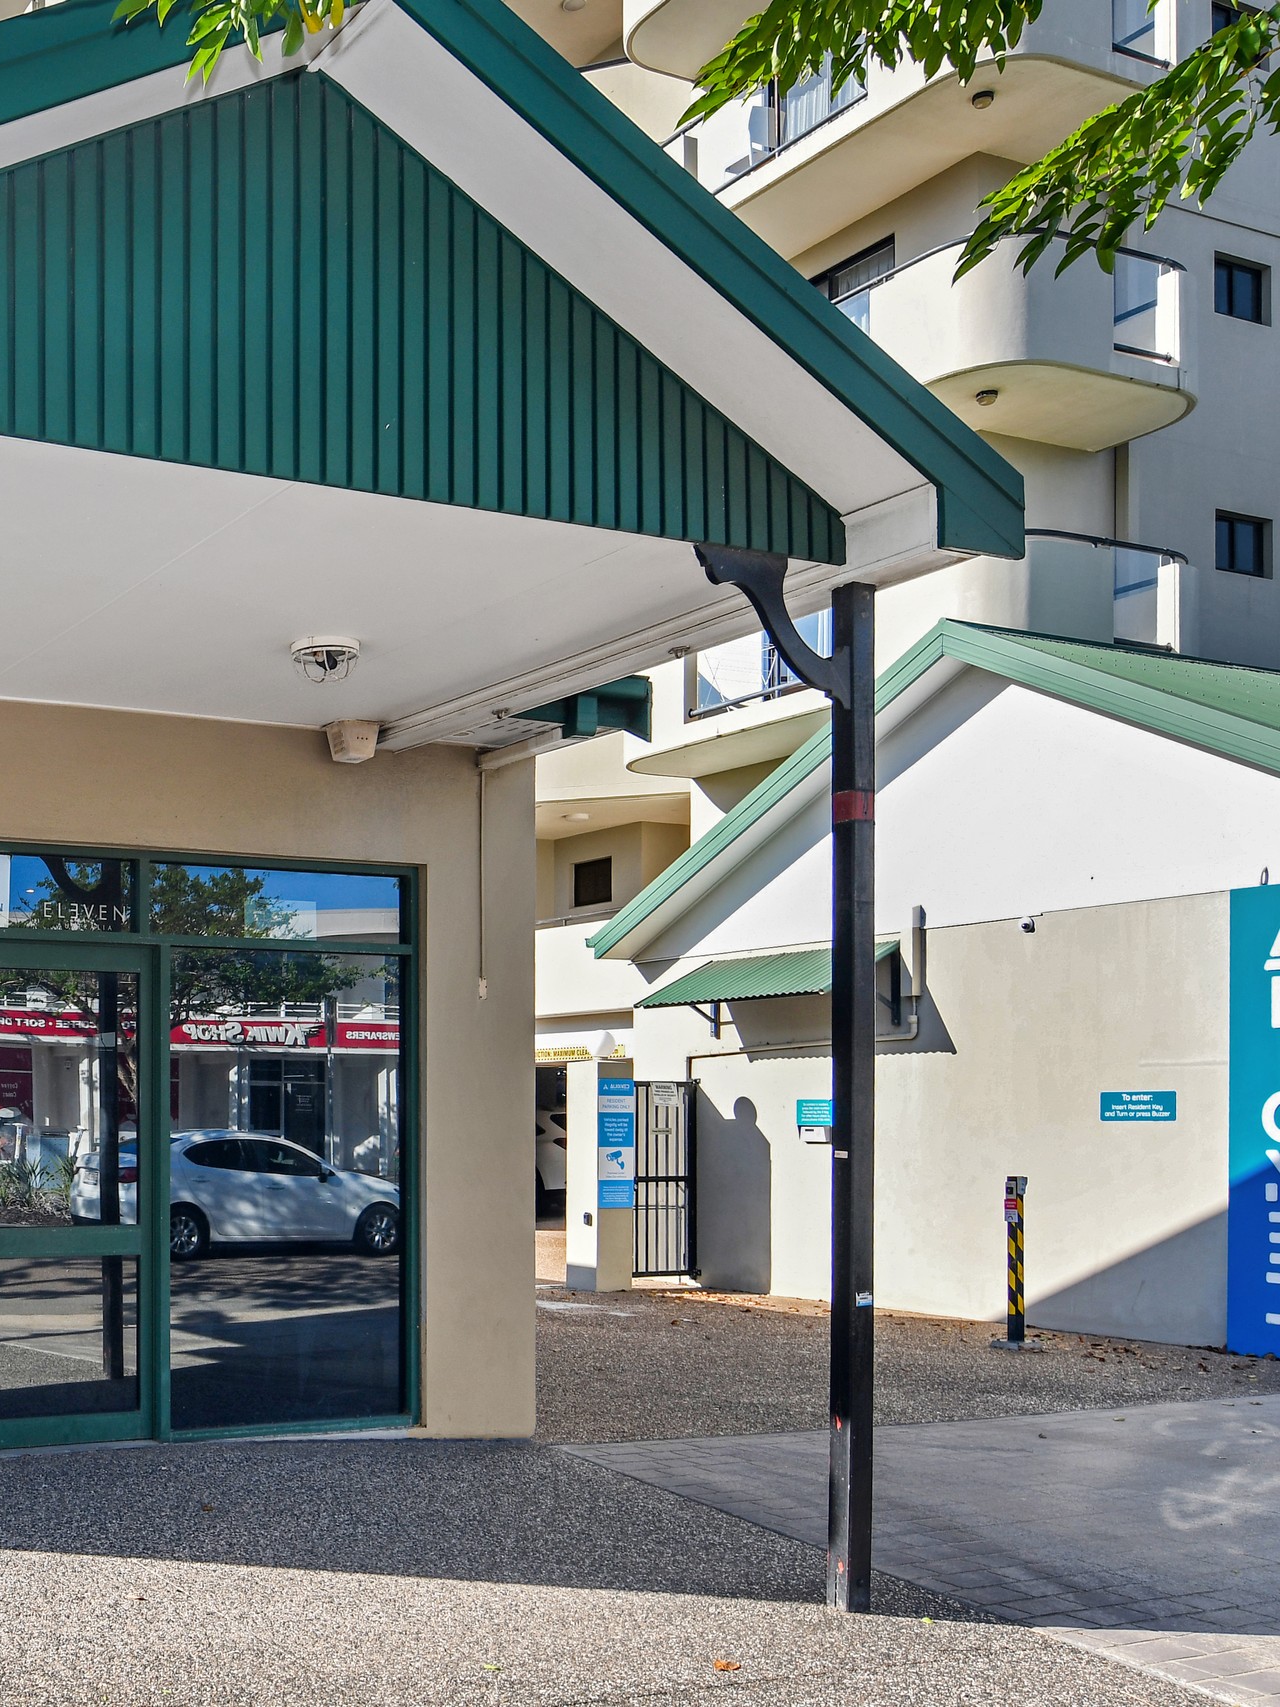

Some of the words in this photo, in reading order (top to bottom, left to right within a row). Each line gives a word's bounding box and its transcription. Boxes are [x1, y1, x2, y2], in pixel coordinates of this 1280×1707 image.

[553, 1049, 576, 1057] MAXIMUM
[1121, 1093, 1131, 1102] To
[1131, 1094, 1154, 1102] enter:
[1151, 1103, 1164, 1111] Key
